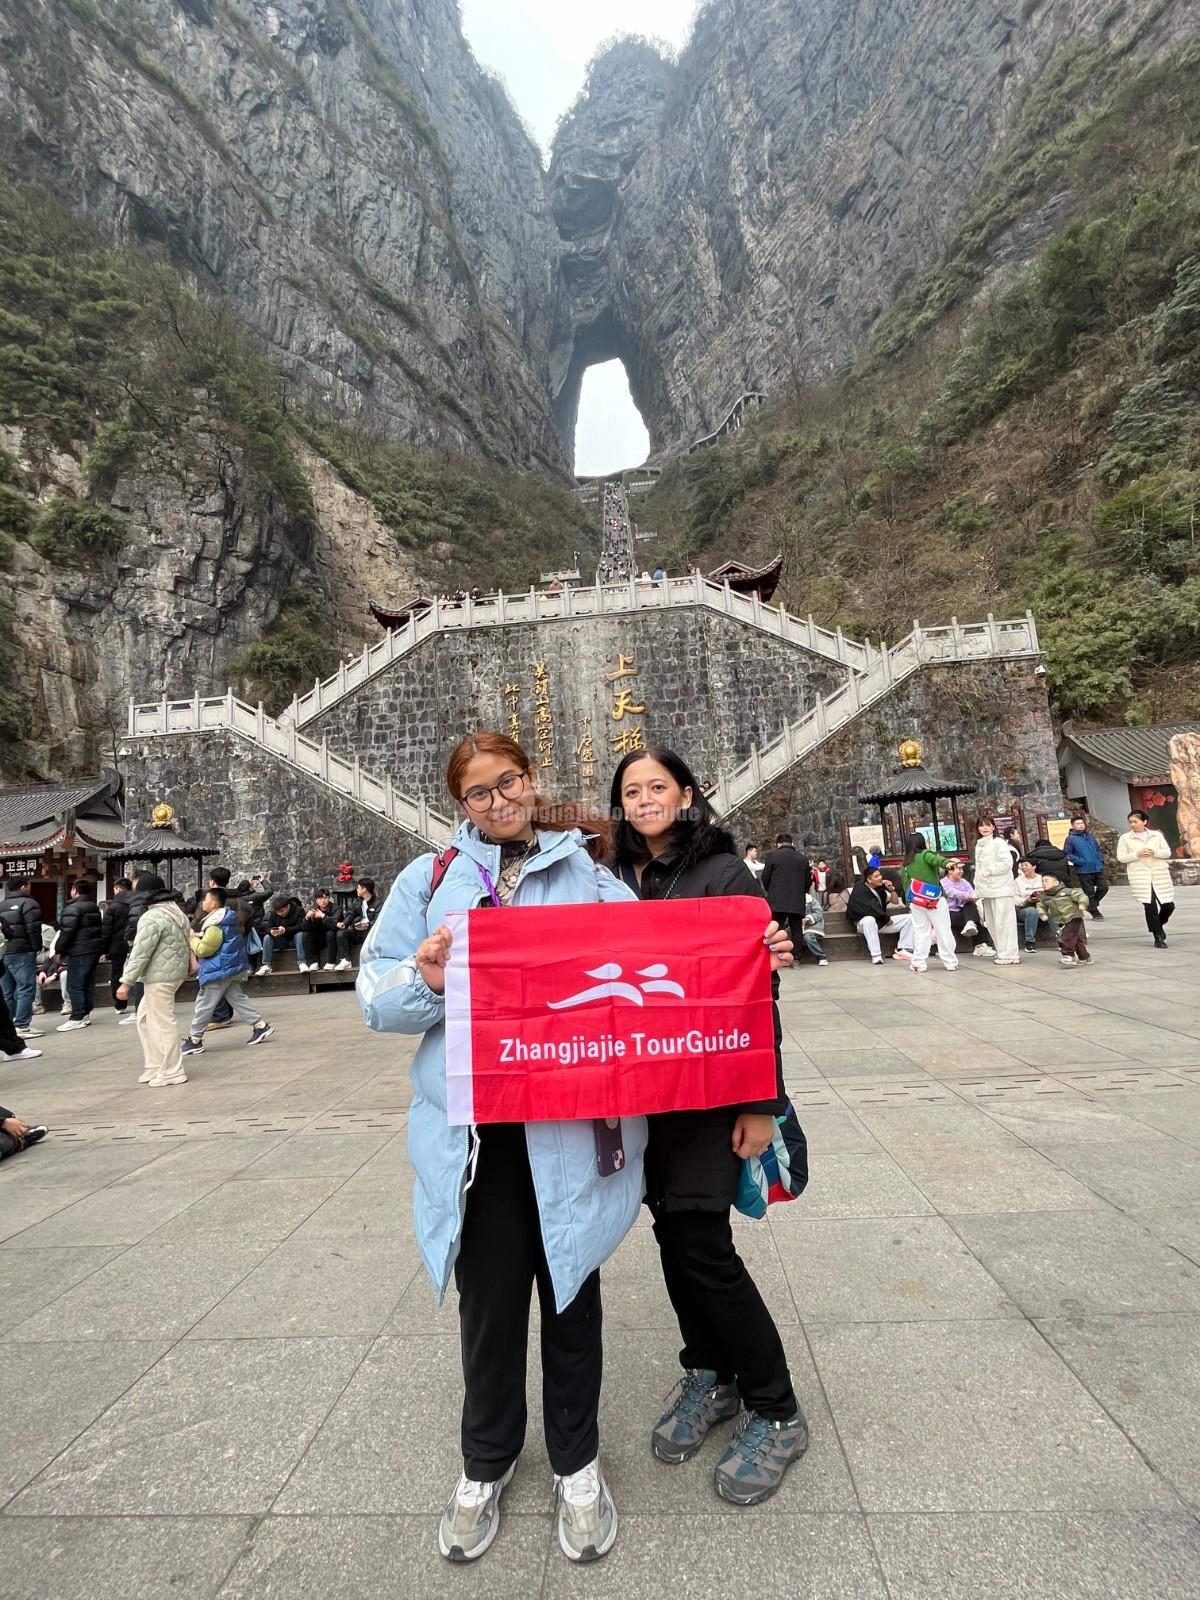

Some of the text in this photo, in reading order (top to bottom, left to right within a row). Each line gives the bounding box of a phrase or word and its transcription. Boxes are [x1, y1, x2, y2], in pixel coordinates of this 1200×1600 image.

[5, 859, 37, 872] 卫生间
[500, 1028, 750, 1064] Zhangjiajie TourGuide
